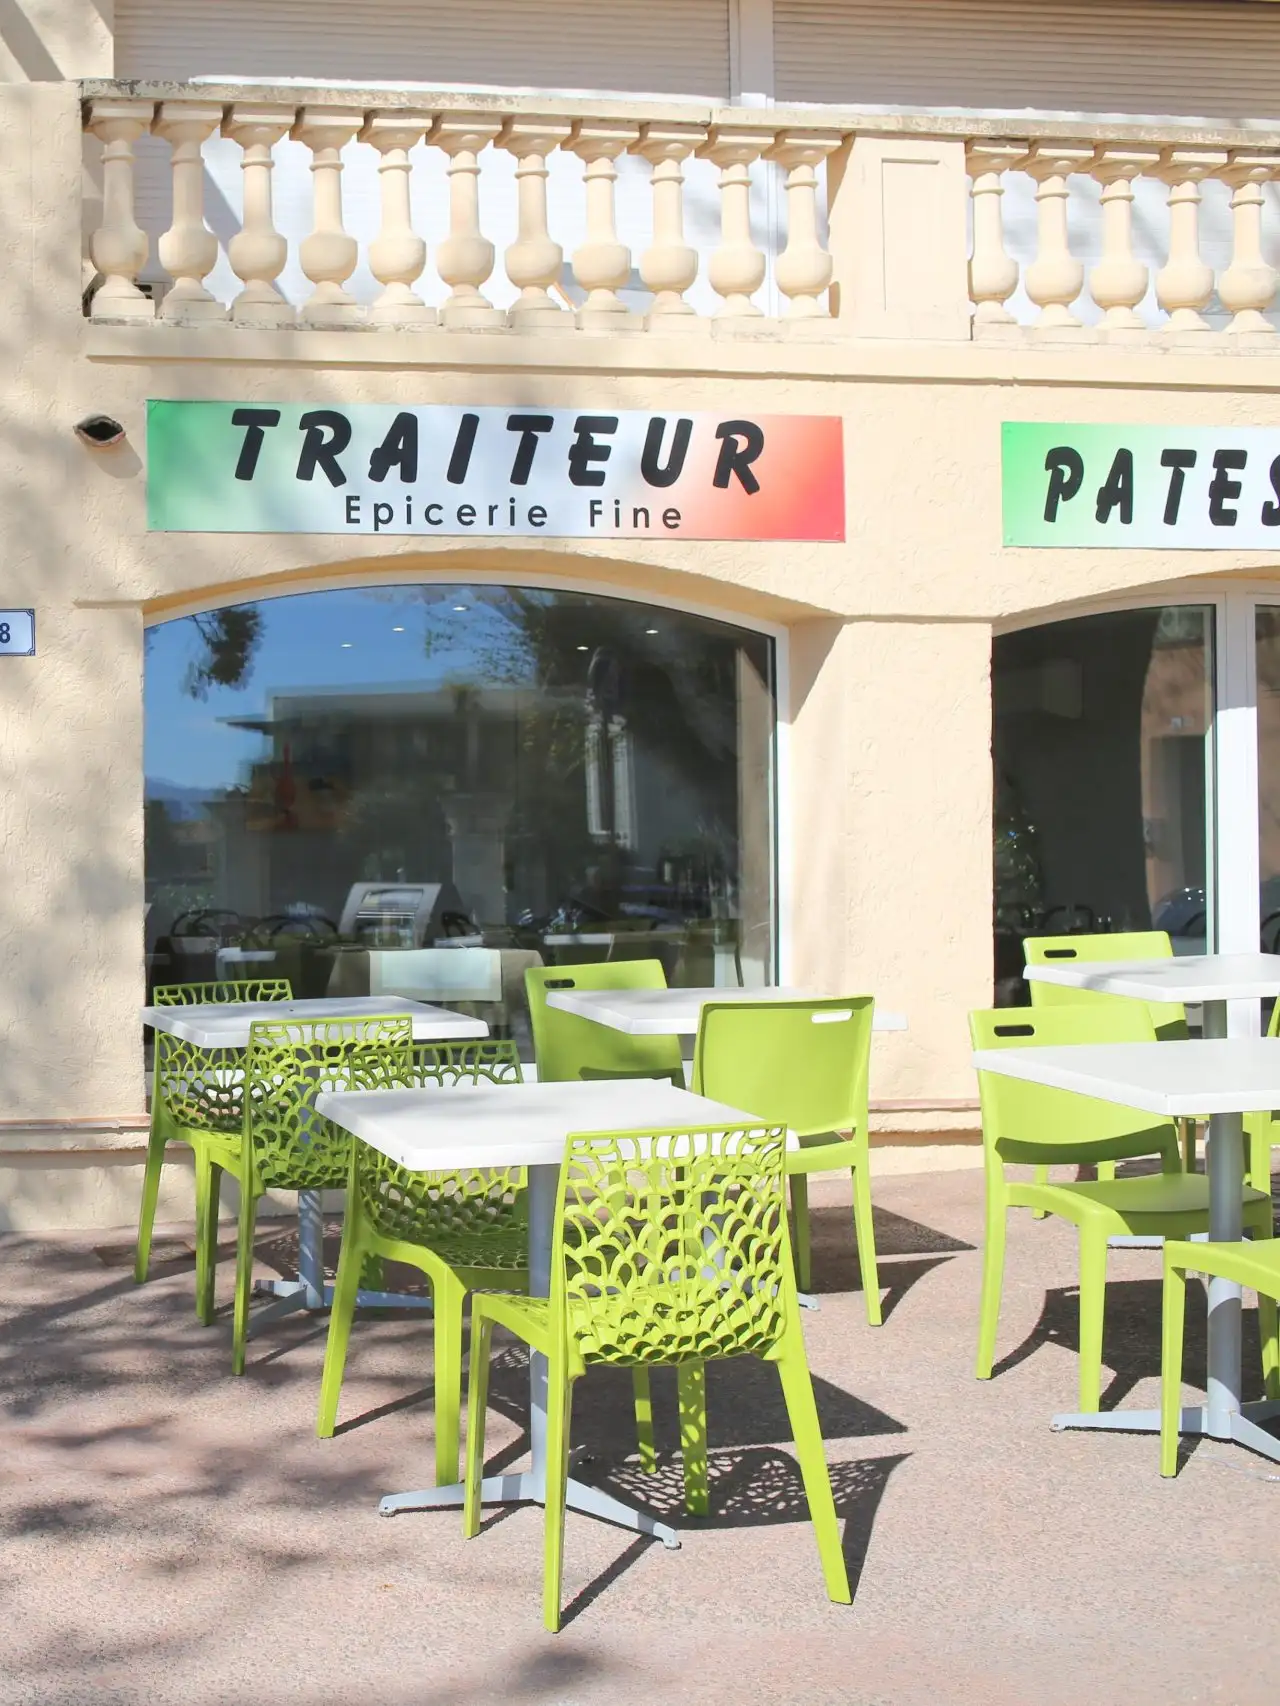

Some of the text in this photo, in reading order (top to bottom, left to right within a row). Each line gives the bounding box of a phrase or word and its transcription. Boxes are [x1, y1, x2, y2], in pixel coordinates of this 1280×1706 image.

[231, 408, 766, 496] TRAITEUR
[345, 496, 683, 531] Epicerie Fine
